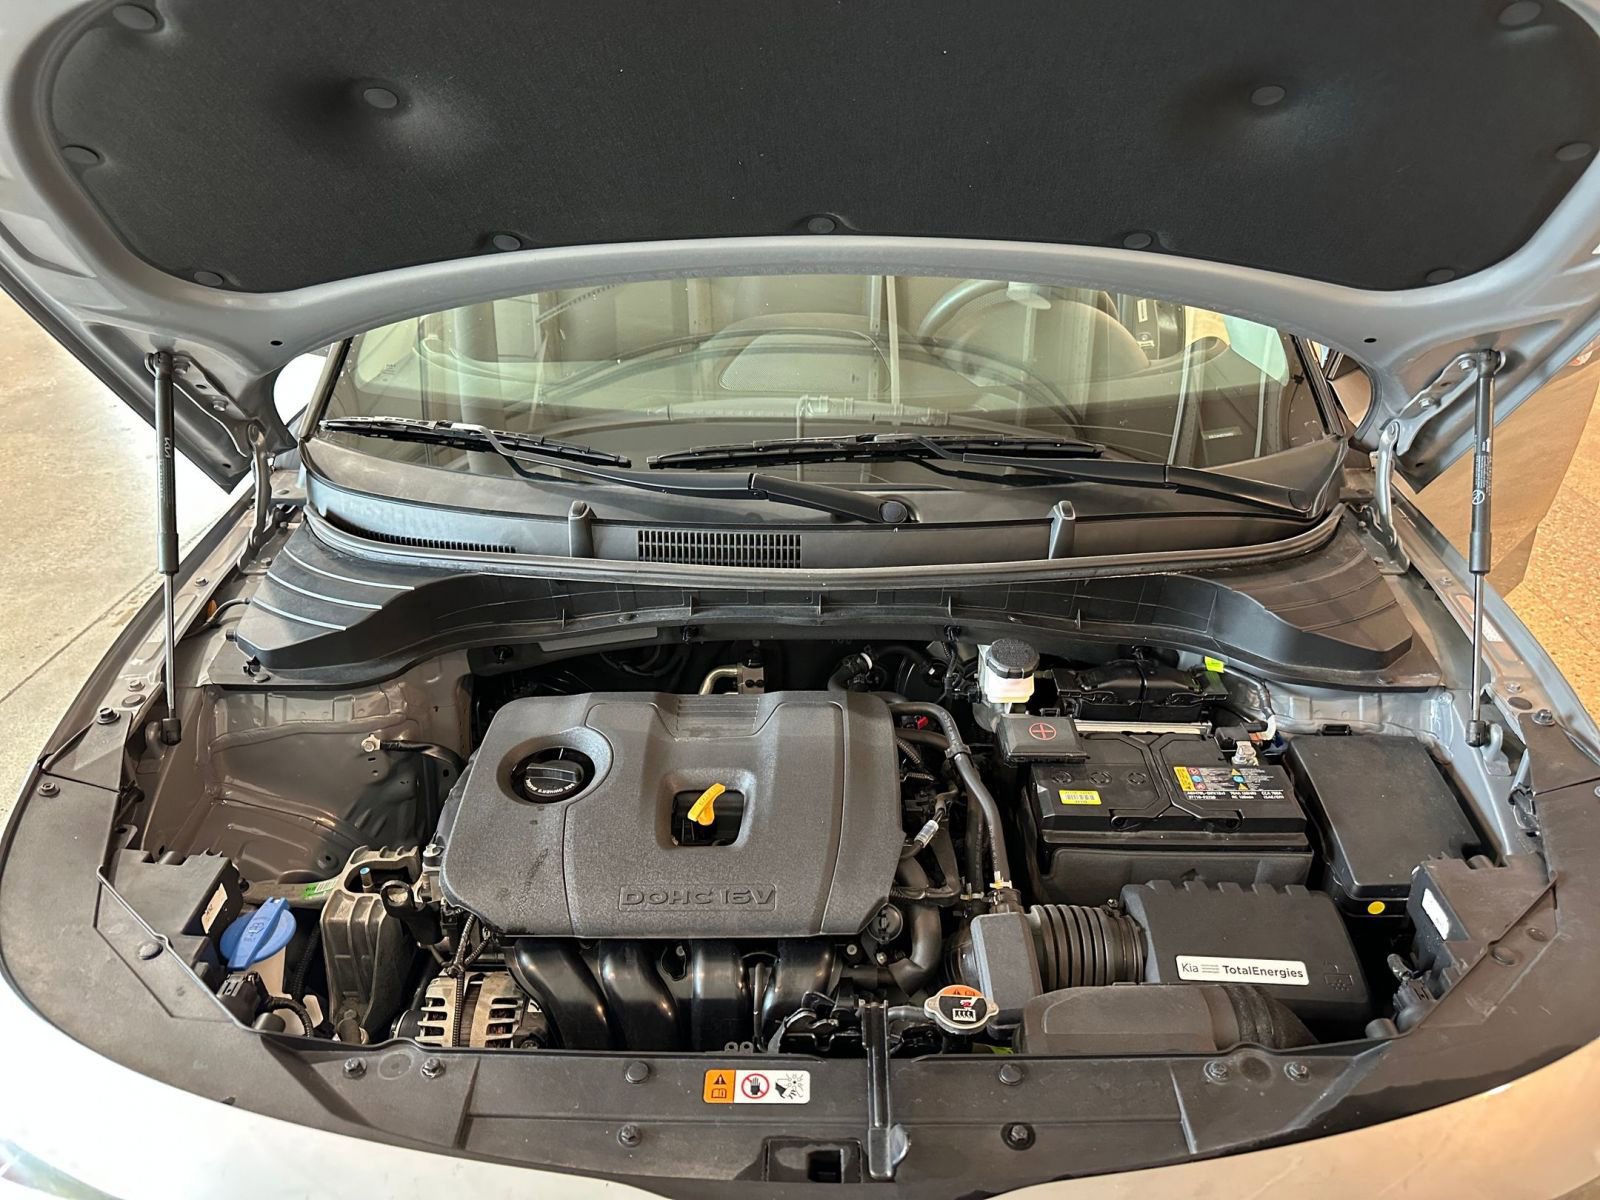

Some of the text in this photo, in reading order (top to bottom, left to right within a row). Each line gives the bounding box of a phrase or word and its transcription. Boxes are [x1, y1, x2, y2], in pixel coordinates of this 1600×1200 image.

[620, 888, 775, 905] DOHC 16V
[1181, 962, 1304, 979] Kia TotalEnergies
